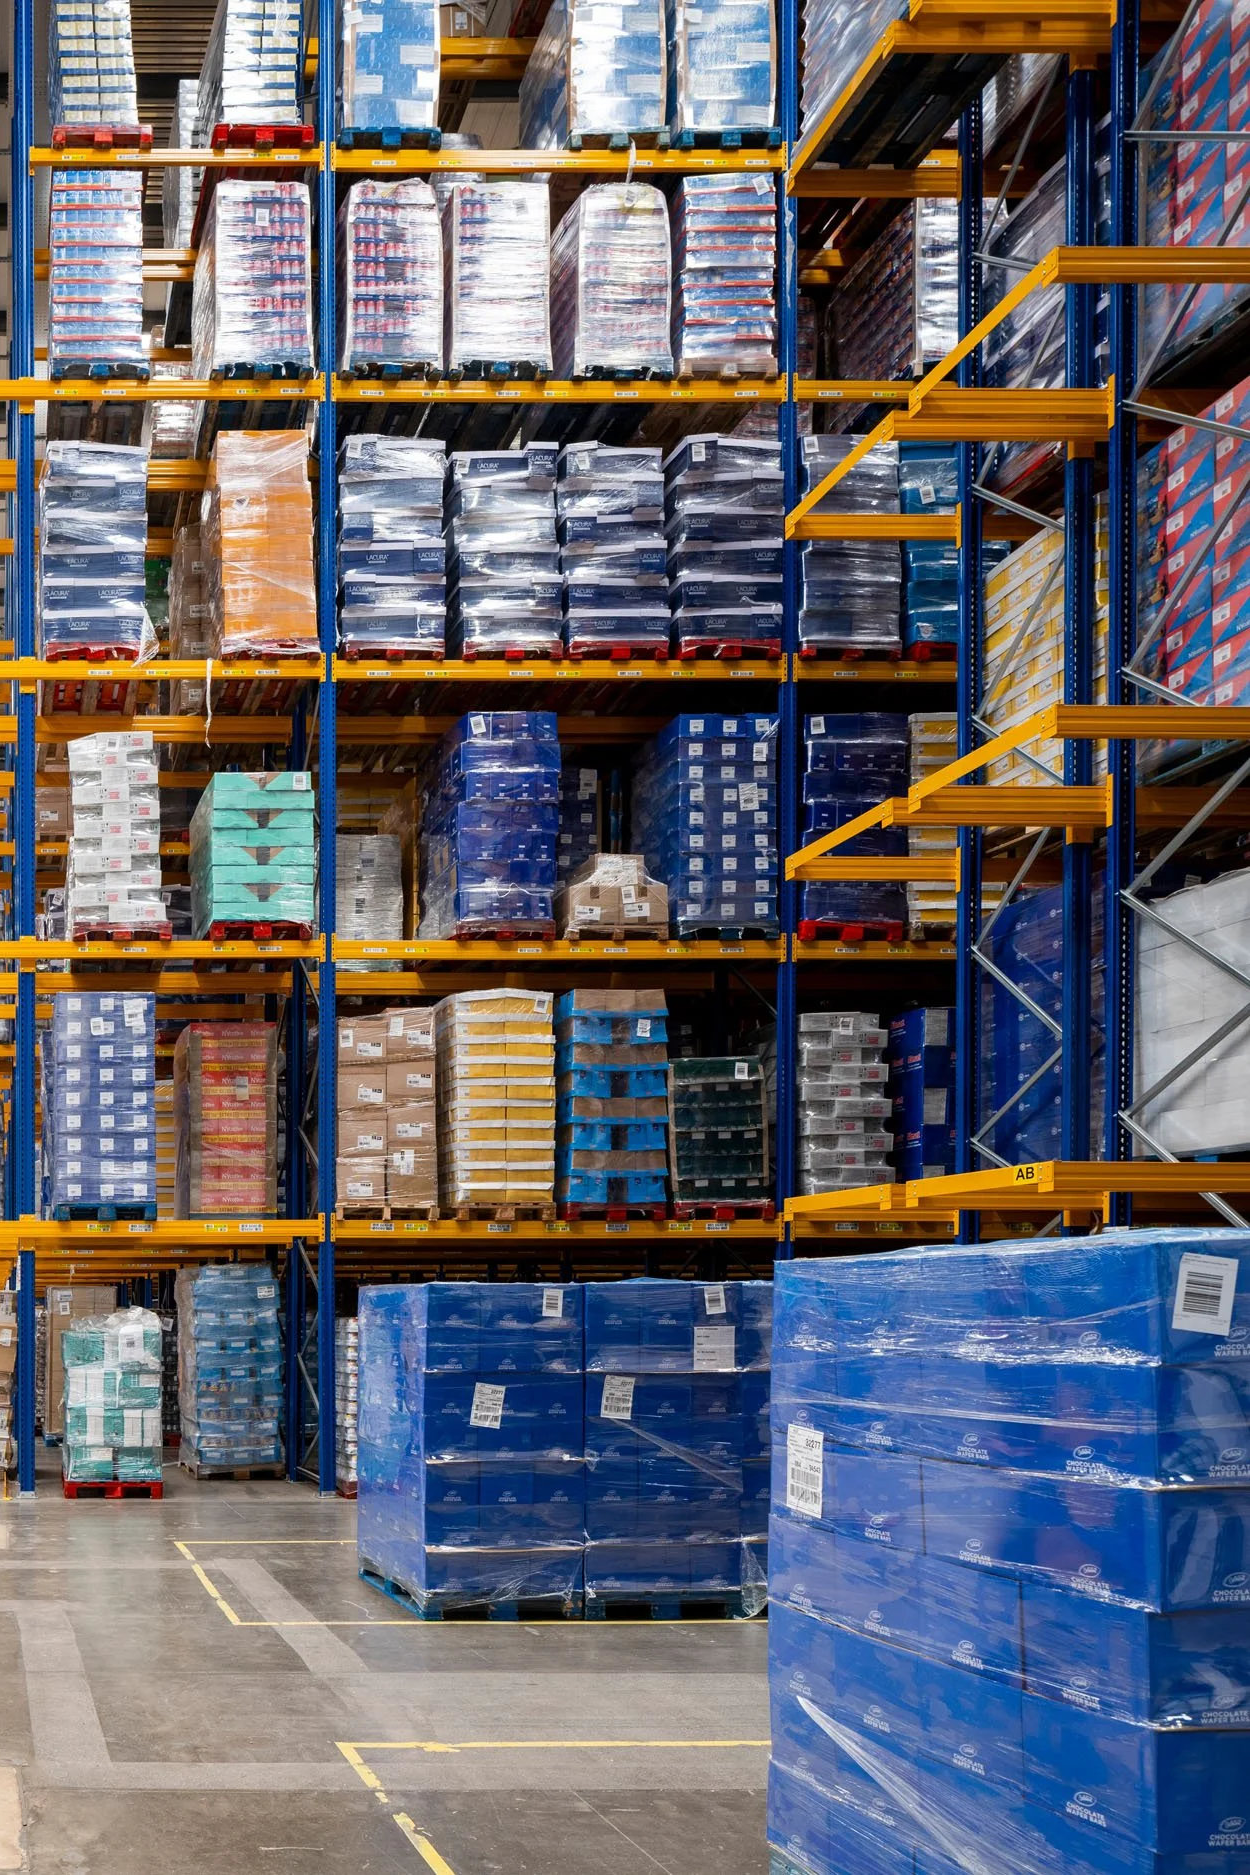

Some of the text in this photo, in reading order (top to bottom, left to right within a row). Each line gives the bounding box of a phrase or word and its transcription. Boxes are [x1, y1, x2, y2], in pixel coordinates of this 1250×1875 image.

[48, 589, 68, 597] LACURA
[349, 585, 371, 593] LACURA
[1015, 1166, 1035, 1181] AB
[1215, 1343, 1250, 1351] CHOCOLA
[957, 1445, 988, 1455] CHOCOLATE
[956, 1450, 990, 1461] WAFER BARS
[1065, 1459, 1103, 1469] CHOCOLATE
[1065, 1466, 1088, 1474] WAFER
[864, 1532, 892, 1542] WAFER BARS
[865, 1527, 891, 1537] CHOCOLATE
[959, 1550, 991, 1562] CHOCOLATE
[958, 1555, 992, 1568] WAFER BARS
[1213, 1589, 1250, 1597] CHOCOLA
[864, 1619, 890, 1632] CHOCOLATE
[1202, 1710, 1249, 1718] CHOCOLATE
[863, 1713, 890, 1728] CHOCOLATE
[1200, 1715, 1250, 1724] WAFER BARS
[863, 1718, 891, 1733] WAFER BARS
[953, 1753, 984, 1769] CHOCOLATE
[952, 1758, 986, 1776] WAFER BARS
[1066, 1801, 1105, 1820] CHOCOLATE
[1065, 1806, 1107, 1828] WAFER BARS
[1209, 1833, 1250, 1841] CHOCOLAT
